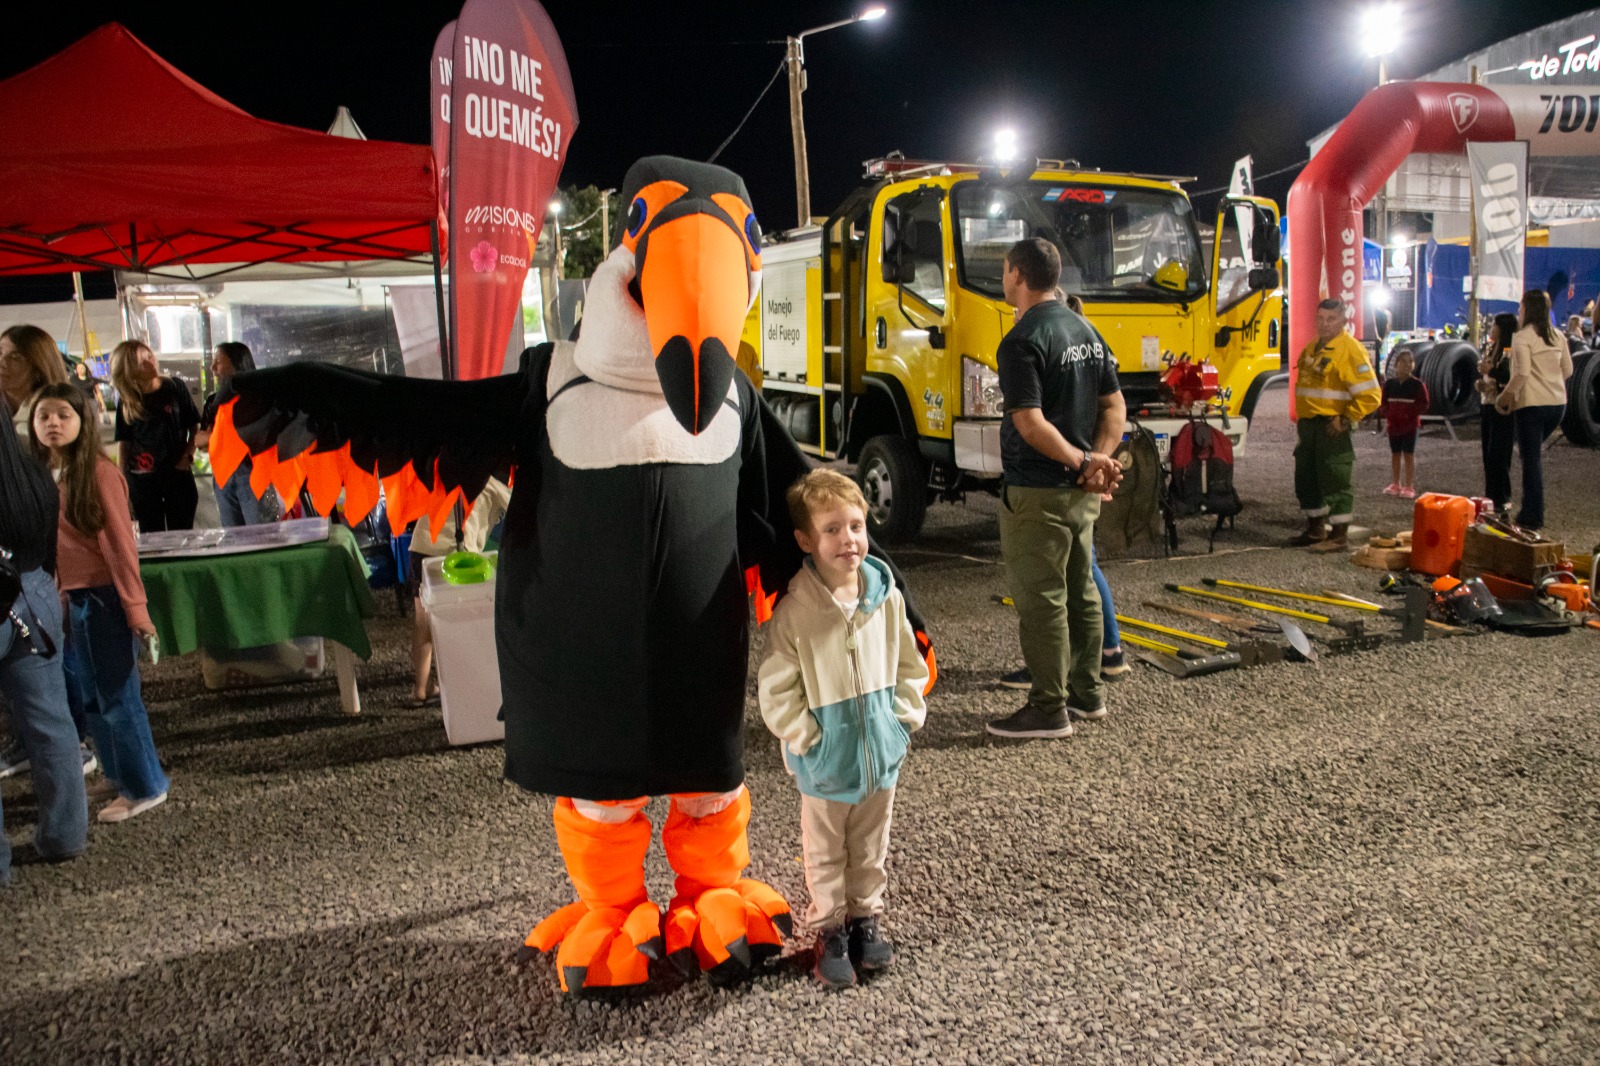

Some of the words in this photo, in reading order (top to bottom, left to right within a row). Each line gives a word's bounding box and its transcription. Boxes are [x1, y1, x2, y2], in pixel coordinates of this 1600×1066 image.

[464, 35, 505, 86] ¡NO
[510, 49, 544, 102] ME
[465, 93, 561, 161] QUEMÉS!
[465, 205, 535, 233] MISIONES
[767, 297, 793, 318] Manejo
[767, 323, 778, 341] del
[779, 325, 801, 346] Fuego
[1241, 319, 1261, 342] MF
